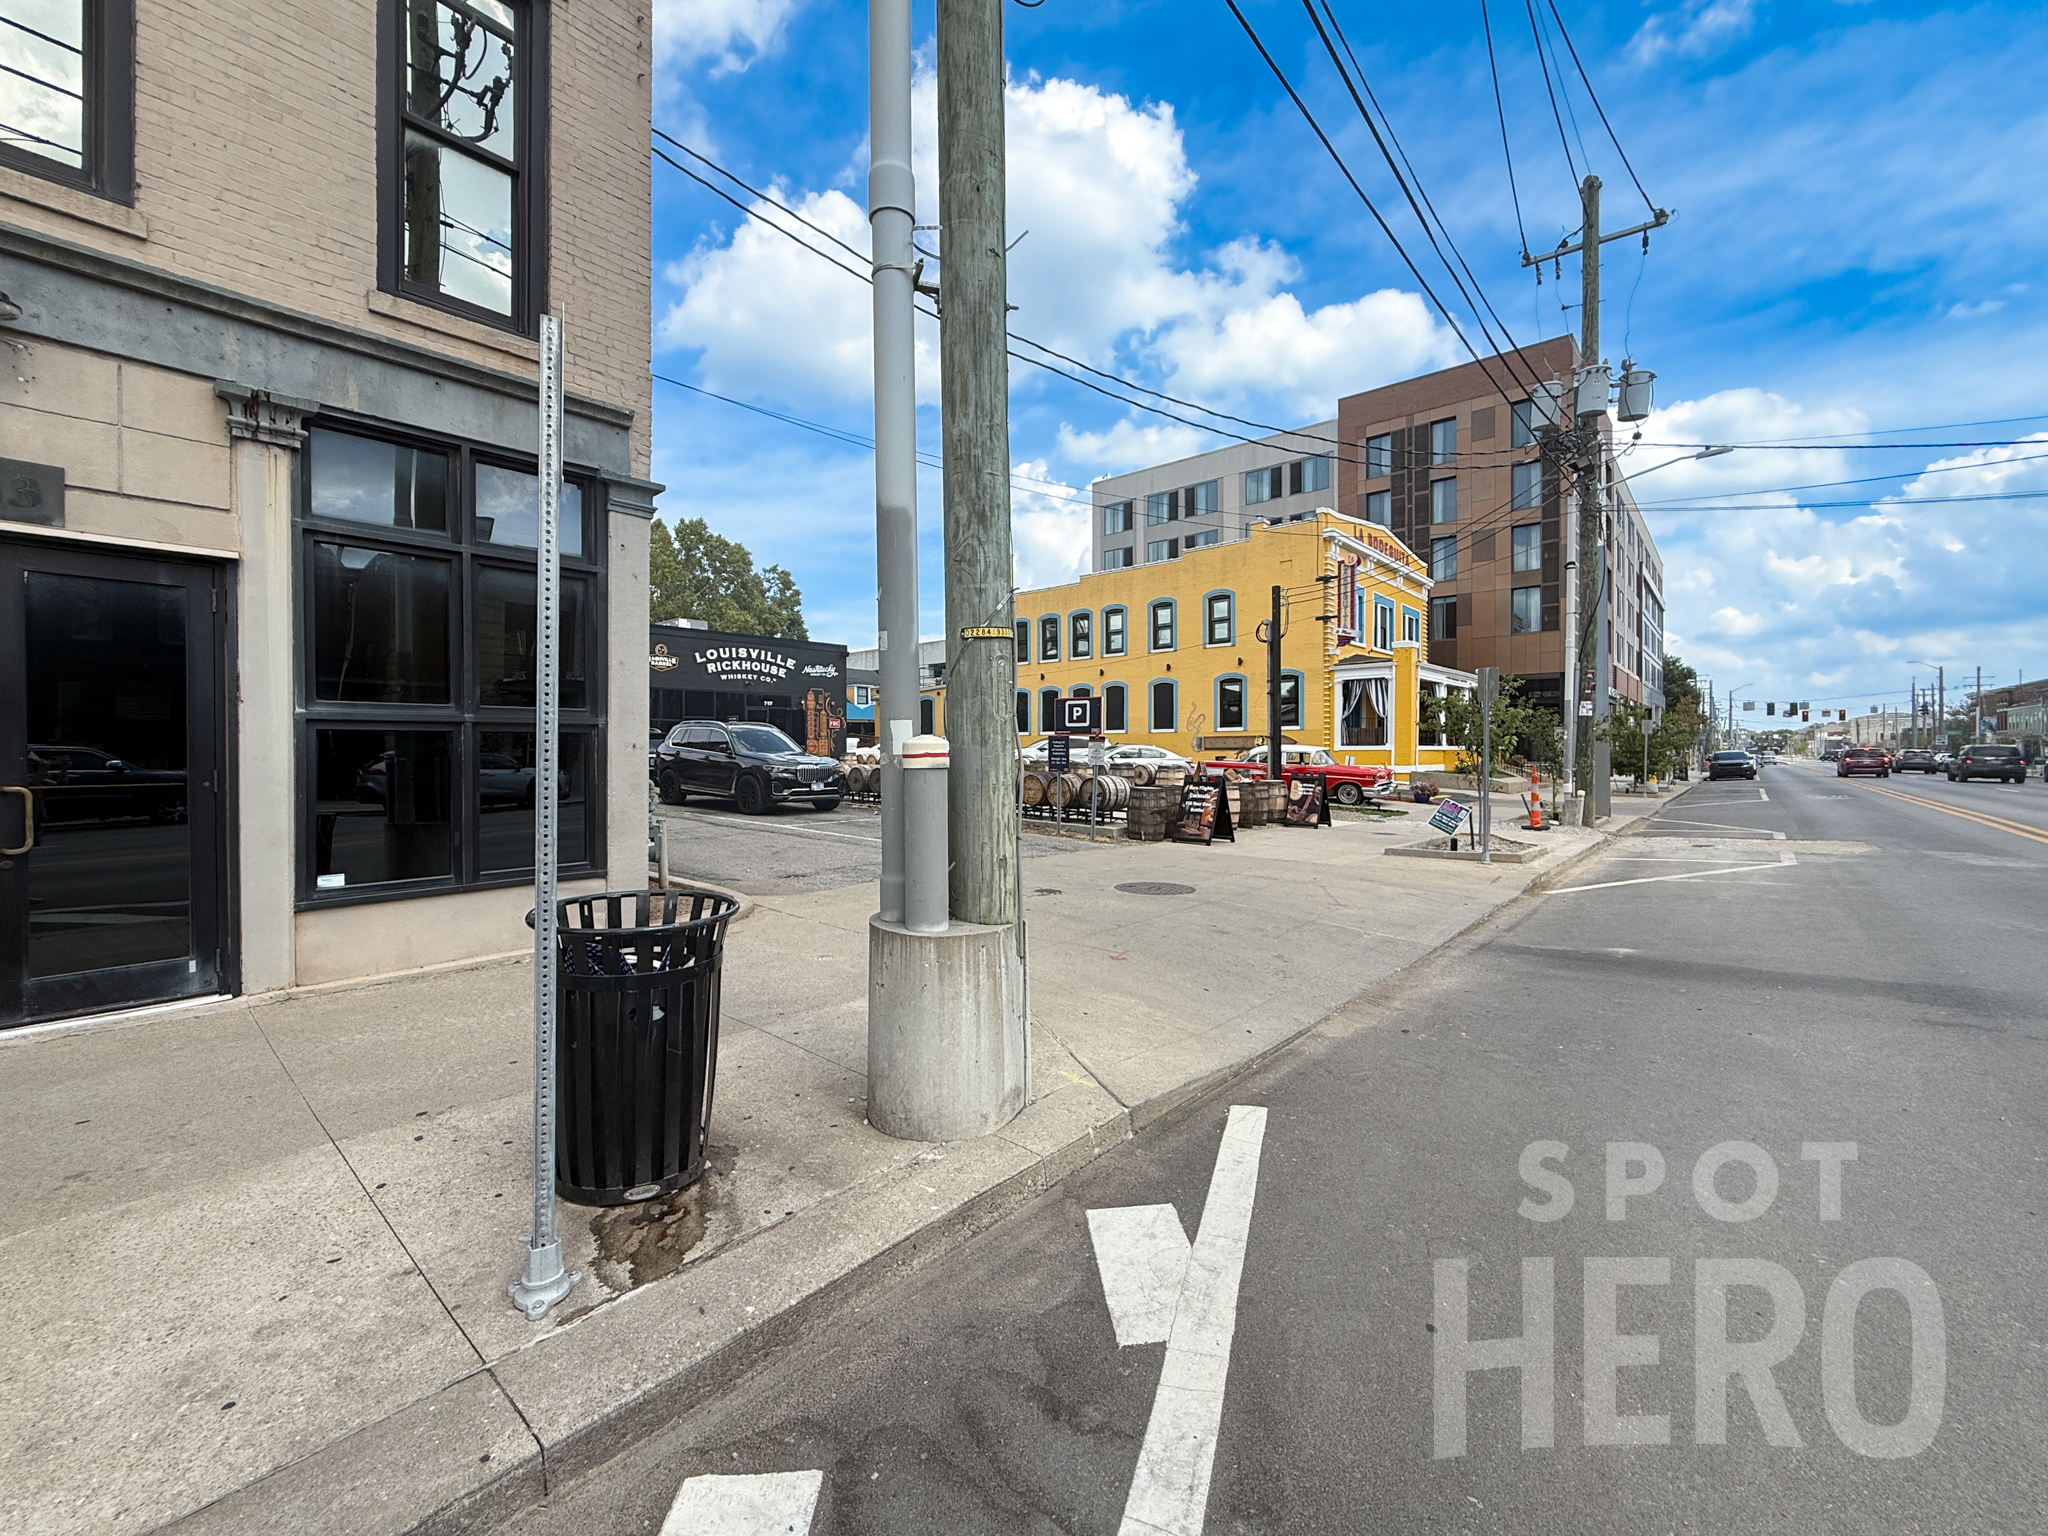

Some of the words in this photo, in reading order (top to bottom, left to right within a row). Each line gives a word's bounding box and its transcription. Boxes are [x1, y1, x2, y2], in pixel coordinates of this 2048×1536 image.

[0, 476, 42, 509] 3
[1353, 525, 1364, 544] LA
[1367, 532, 1410, 566] BODEGUITA
[694, 647, 797, 670] LOUISVILLE
[706, 660, 787, 678] RICKHOUSE
[720, 673, 758, 681] WHISKEY
[1073, 706, 1083, 720] P
